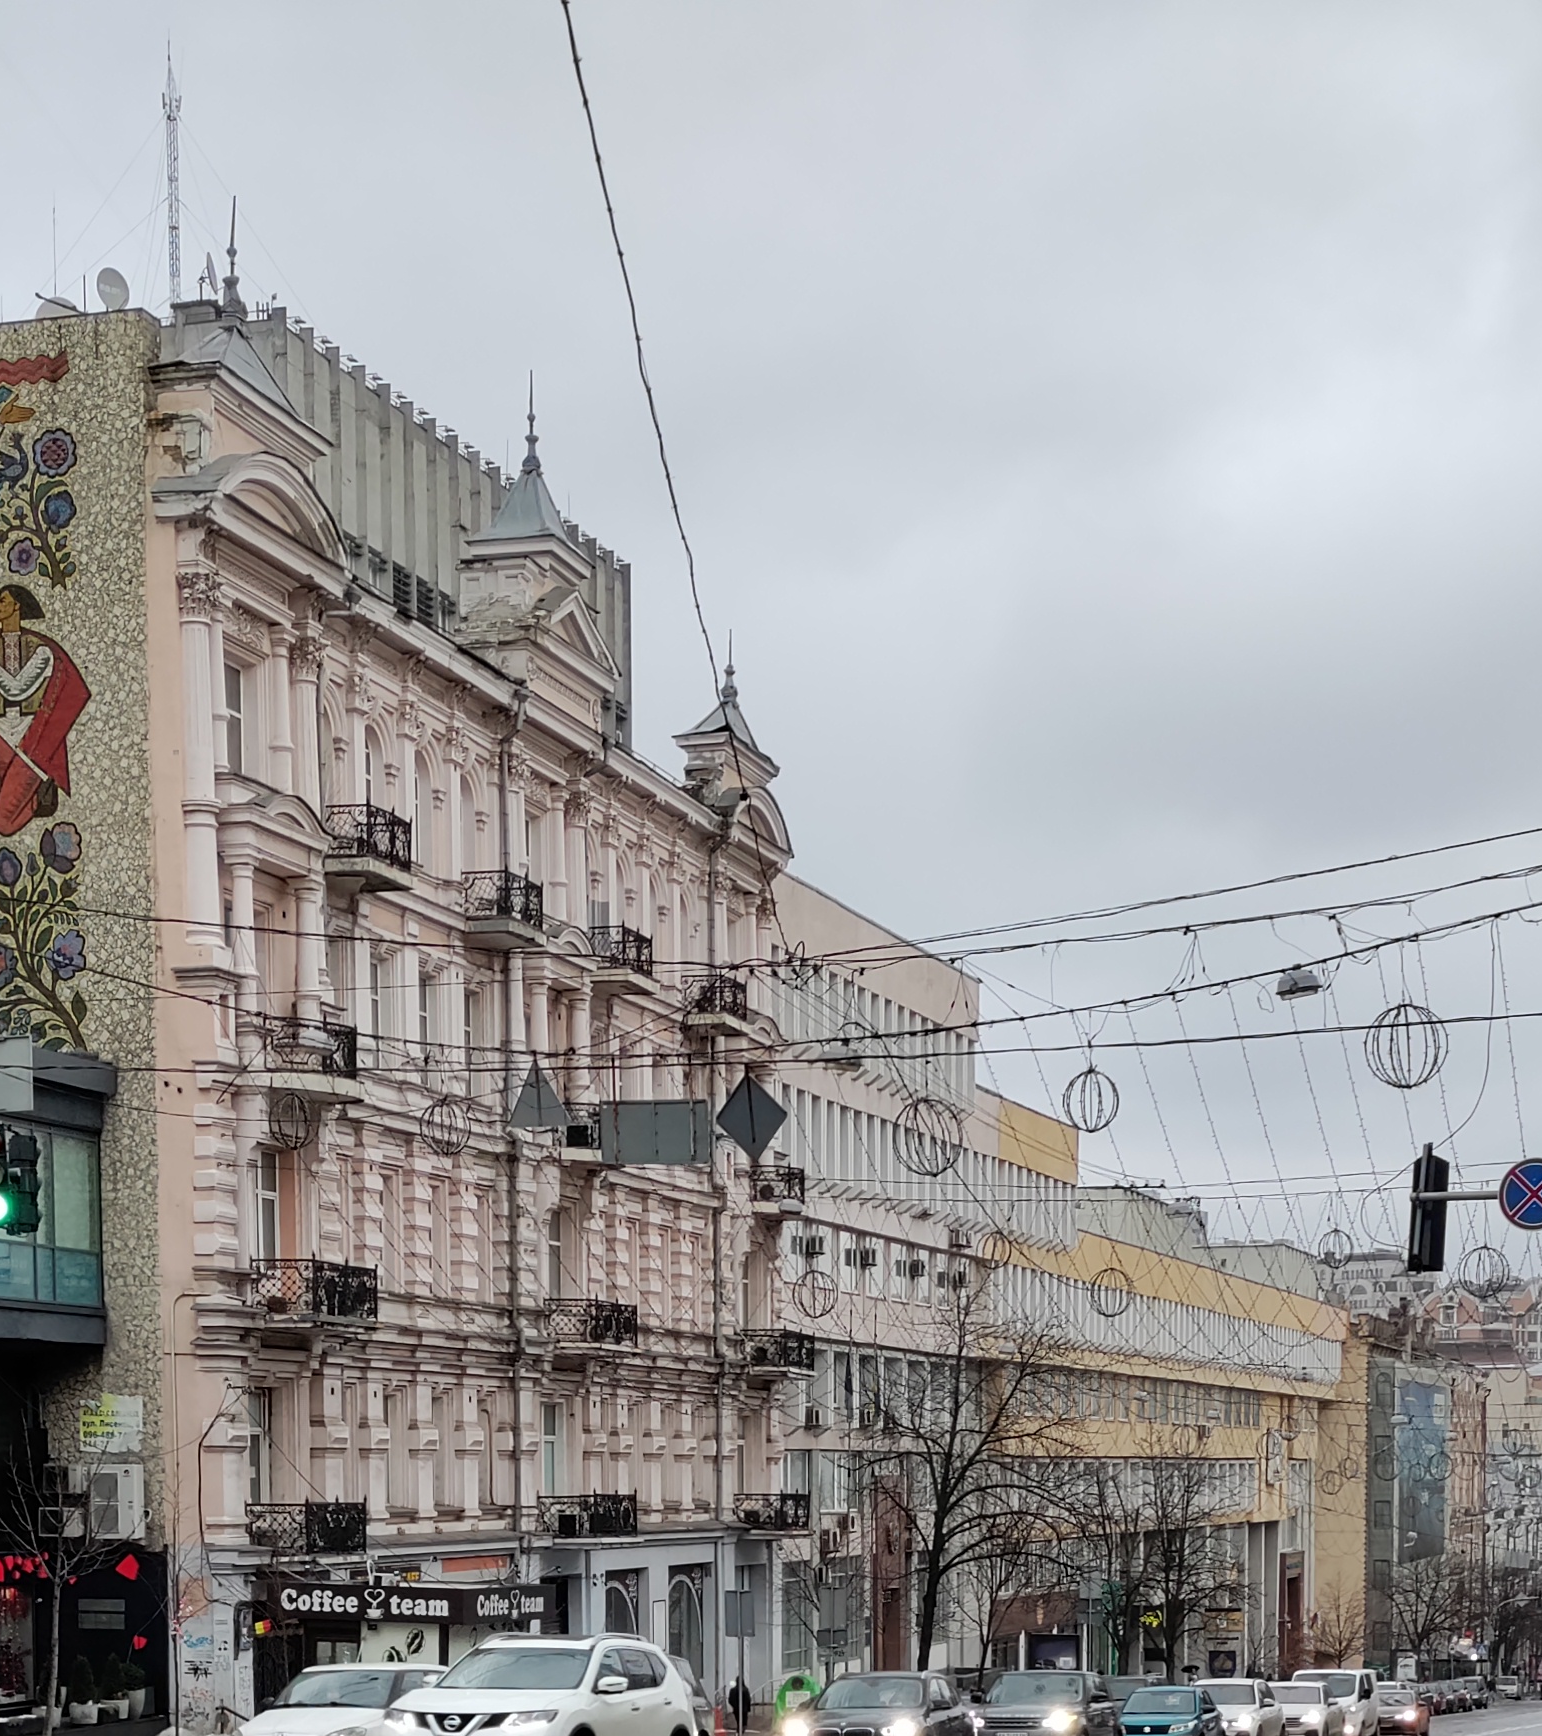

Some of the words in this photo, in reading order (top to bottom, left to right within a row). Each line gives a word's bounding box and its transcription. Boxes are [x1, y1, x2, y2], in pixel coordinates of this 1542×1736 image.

[280, 1588, 359, 1613] Coffee
[389, 1594, 449, 1617] team
[477, 1594, 509, 1617] Coffee
[521, 1595, 544, 1614] team
